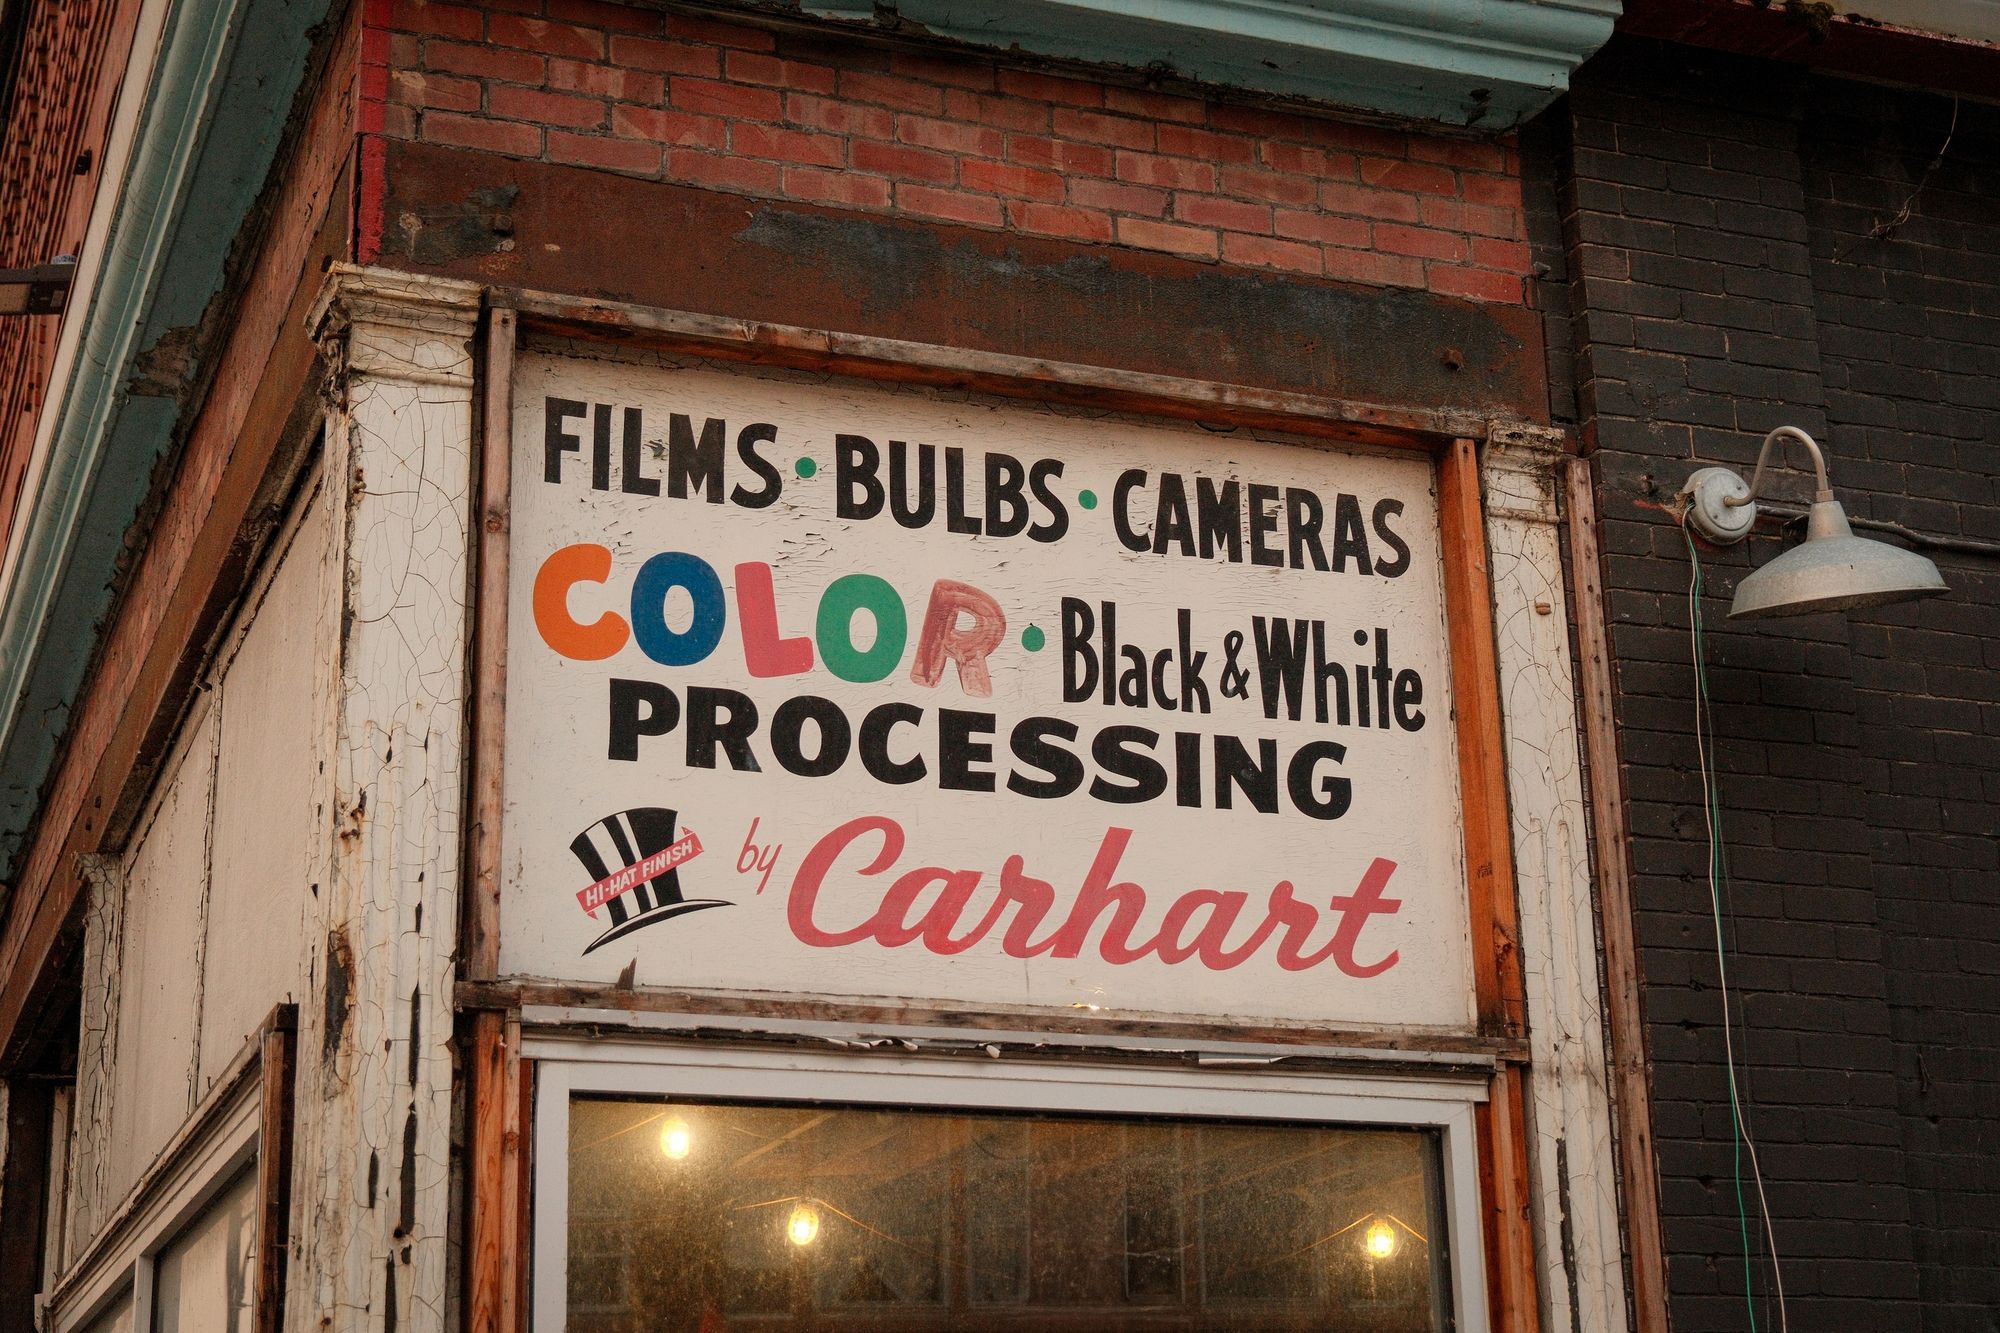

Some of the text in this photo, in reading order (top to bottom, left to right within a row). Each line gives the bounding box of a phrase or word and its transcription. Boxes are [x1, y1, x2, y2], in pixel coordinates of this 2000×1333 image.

[544, 396, 1411, 578] FILMS BULBS CAMERAS
[533, 544, 1426, 732] COLOR Black & White
[608, 678, 1353, 821] PROCESSING
[584, 838, 695, 908] HI-HAT FINISH
[736, 815, 1403, 979] by Carhart
